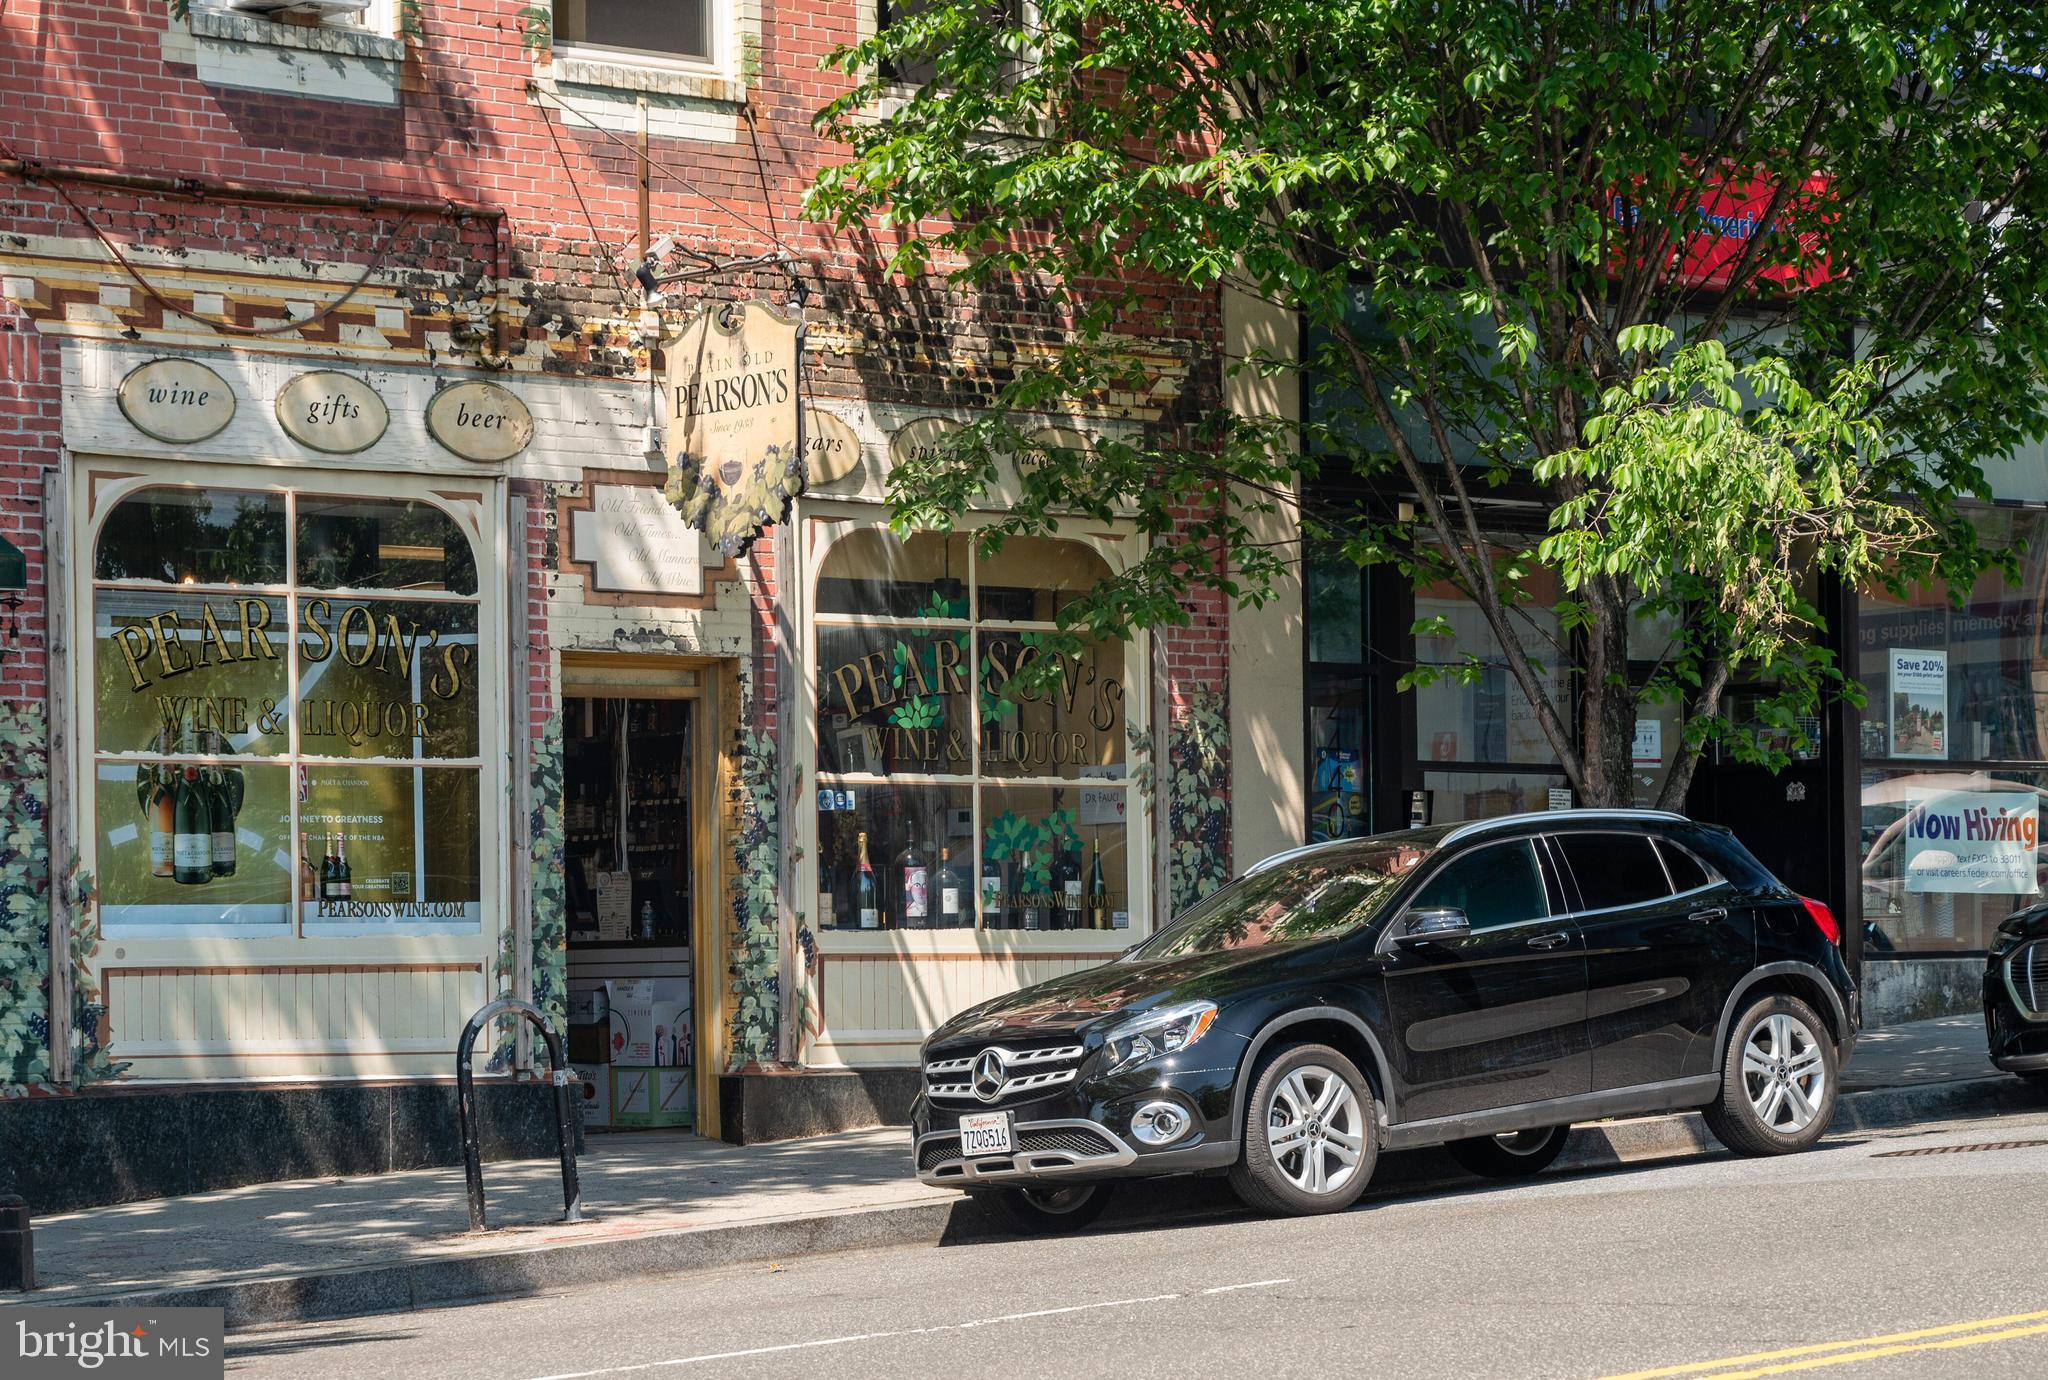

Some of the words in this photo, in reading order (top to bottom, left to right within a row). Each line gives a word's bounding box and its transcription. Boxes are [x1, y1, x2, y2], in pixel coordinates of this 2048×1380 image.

[1695, 206, 1778, 240] Ameri
[687, 357, 733, 376] PLAIN
[742, 349, 774, 367] OLD
[148, 379, 209, 407] wine
[675, 368, 789, 418] PEARSON'S
[307, 394, 360, 425] gifts
[456, 402, 507, 431] beer
[601, 498, 621, 513] Old
[614, 521, 637, 537] Old
[628, 547, 649, 562] Old
[640, 567, 660, 585] Old
[1880, 619, 1945, 642] supplies
[1953, 616, 2021, 633] memory
[1897, 658, 1920, 671] Save
[1922, 660, 1944, 672] 20%
[153, 694, 249, 735] WINE
[255, 697, 285, 736] &
[302, 698, 435, 747] LIQUOR
[861, 726, 939, 762] WINE
[946, 728, 969, 763] &
[984, 729, 1090, 773] LIQUOR
[1085, 793, 1097, 804] DR
[1098, 791, 1119, 803] FAUCI
[321, 815, 334, 823] TO
[335, 815, 384, 824] GREATNESS
[1908, 805, 1960, 840] Now
[1963, 806, 2037, 852] Hiring
[1916, 869, 1924, 877] or
[1925, 868, 1939, 877] visit
[963, 1127, 1007, 1150] 7ZQG516
